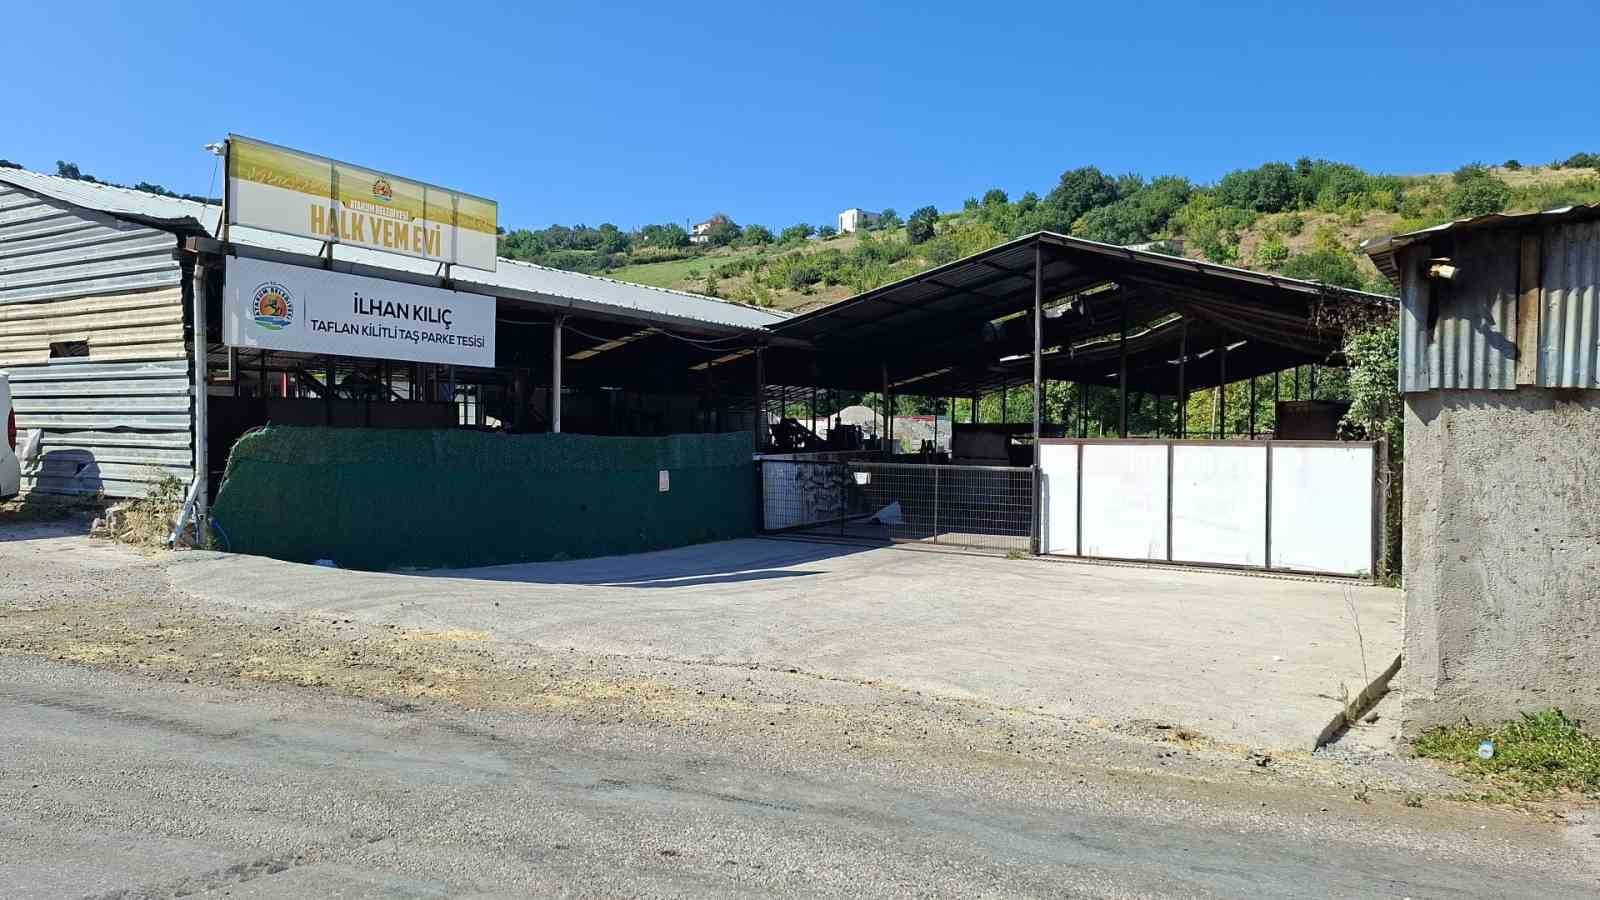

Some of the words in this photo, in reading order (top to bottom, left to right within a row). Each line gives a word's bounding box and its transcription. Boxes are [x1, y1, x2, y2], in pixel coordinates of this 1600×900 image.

[310, 204, 364, 242] HALK
[369, 215, 409, 250] YEM
[414, 224, 441, 257] EVİ
[353, 292, 410, 321] İLHAN
[412, 305, 453, 330] KILIÇ
[311, 319, 359, 336] TAFLAN
[361, 322, 398, 339] KİLİTLİ
[399, 329, 419, 344] TAŞ
[421, 331, 455, 345] PARKE
[456, 334, 485, 348] TESİSİ
